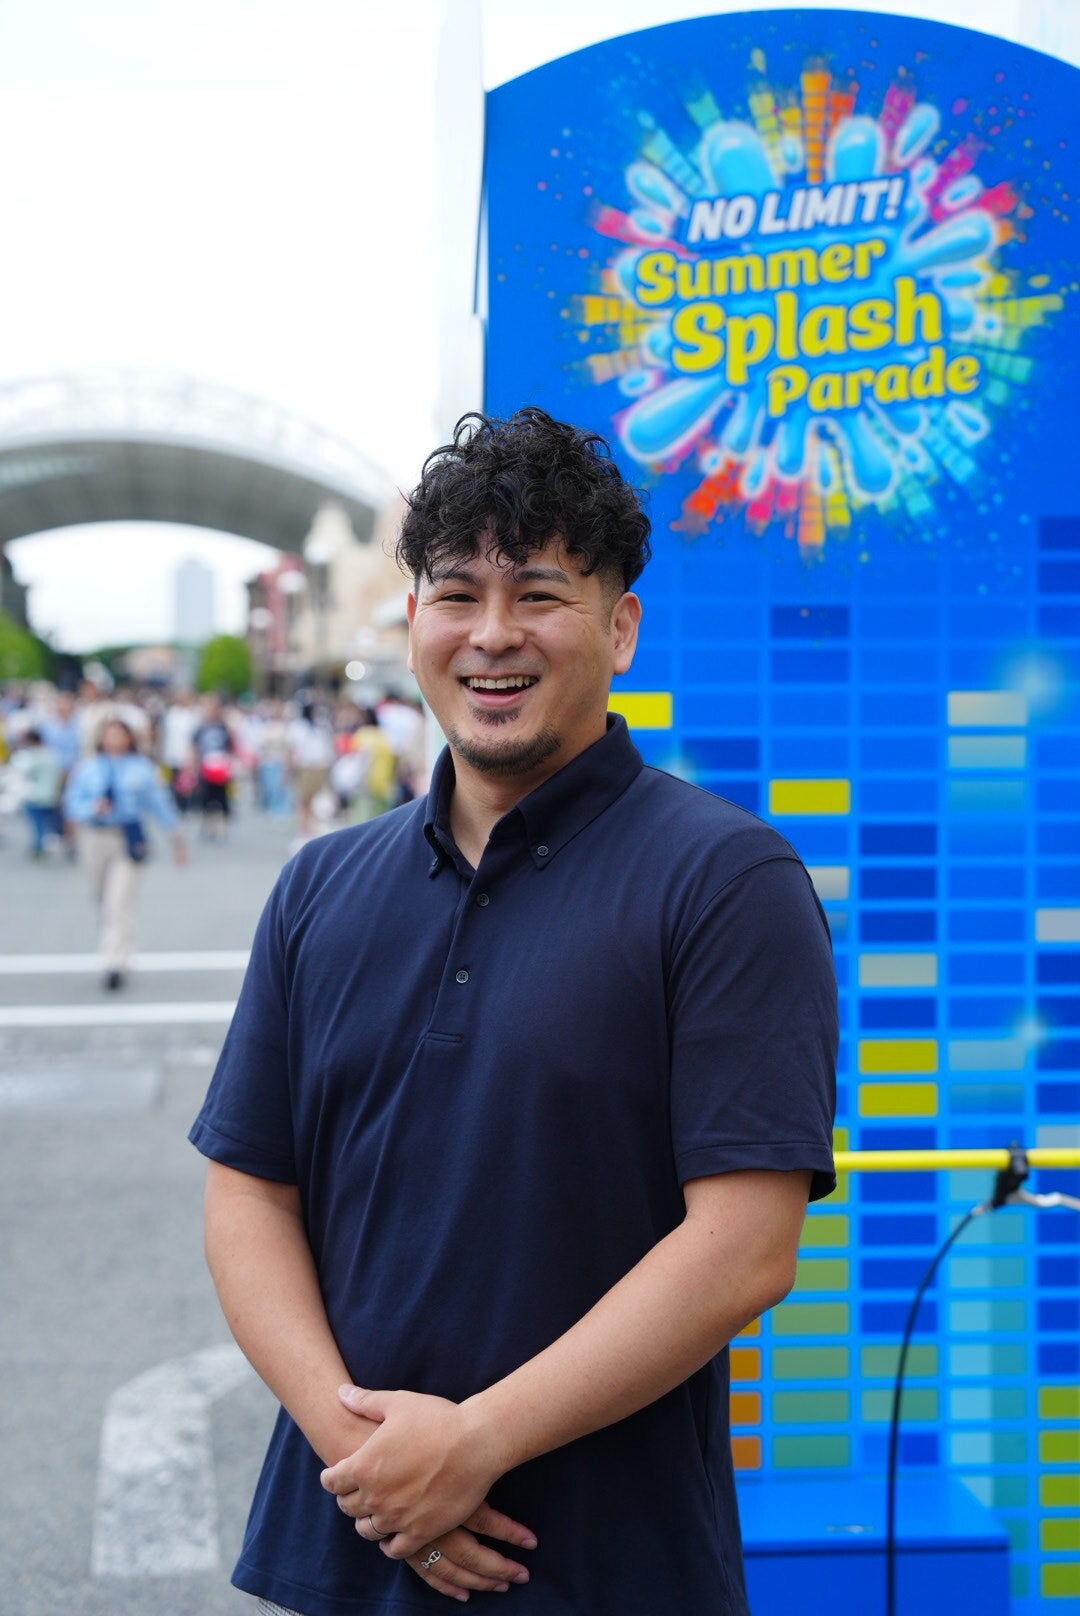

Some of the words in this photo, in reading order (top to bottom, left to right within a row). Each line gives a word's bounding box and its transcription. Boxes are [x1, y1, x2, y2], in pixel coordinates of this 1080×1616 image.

[688, 196, 755, 242] NO
[758, 179, 904, 234] LIMIT!
[636, 240, 885, 304] Summer
[672, 277, 942, 385] Splash
[768, 347, 980, 416] Parade
